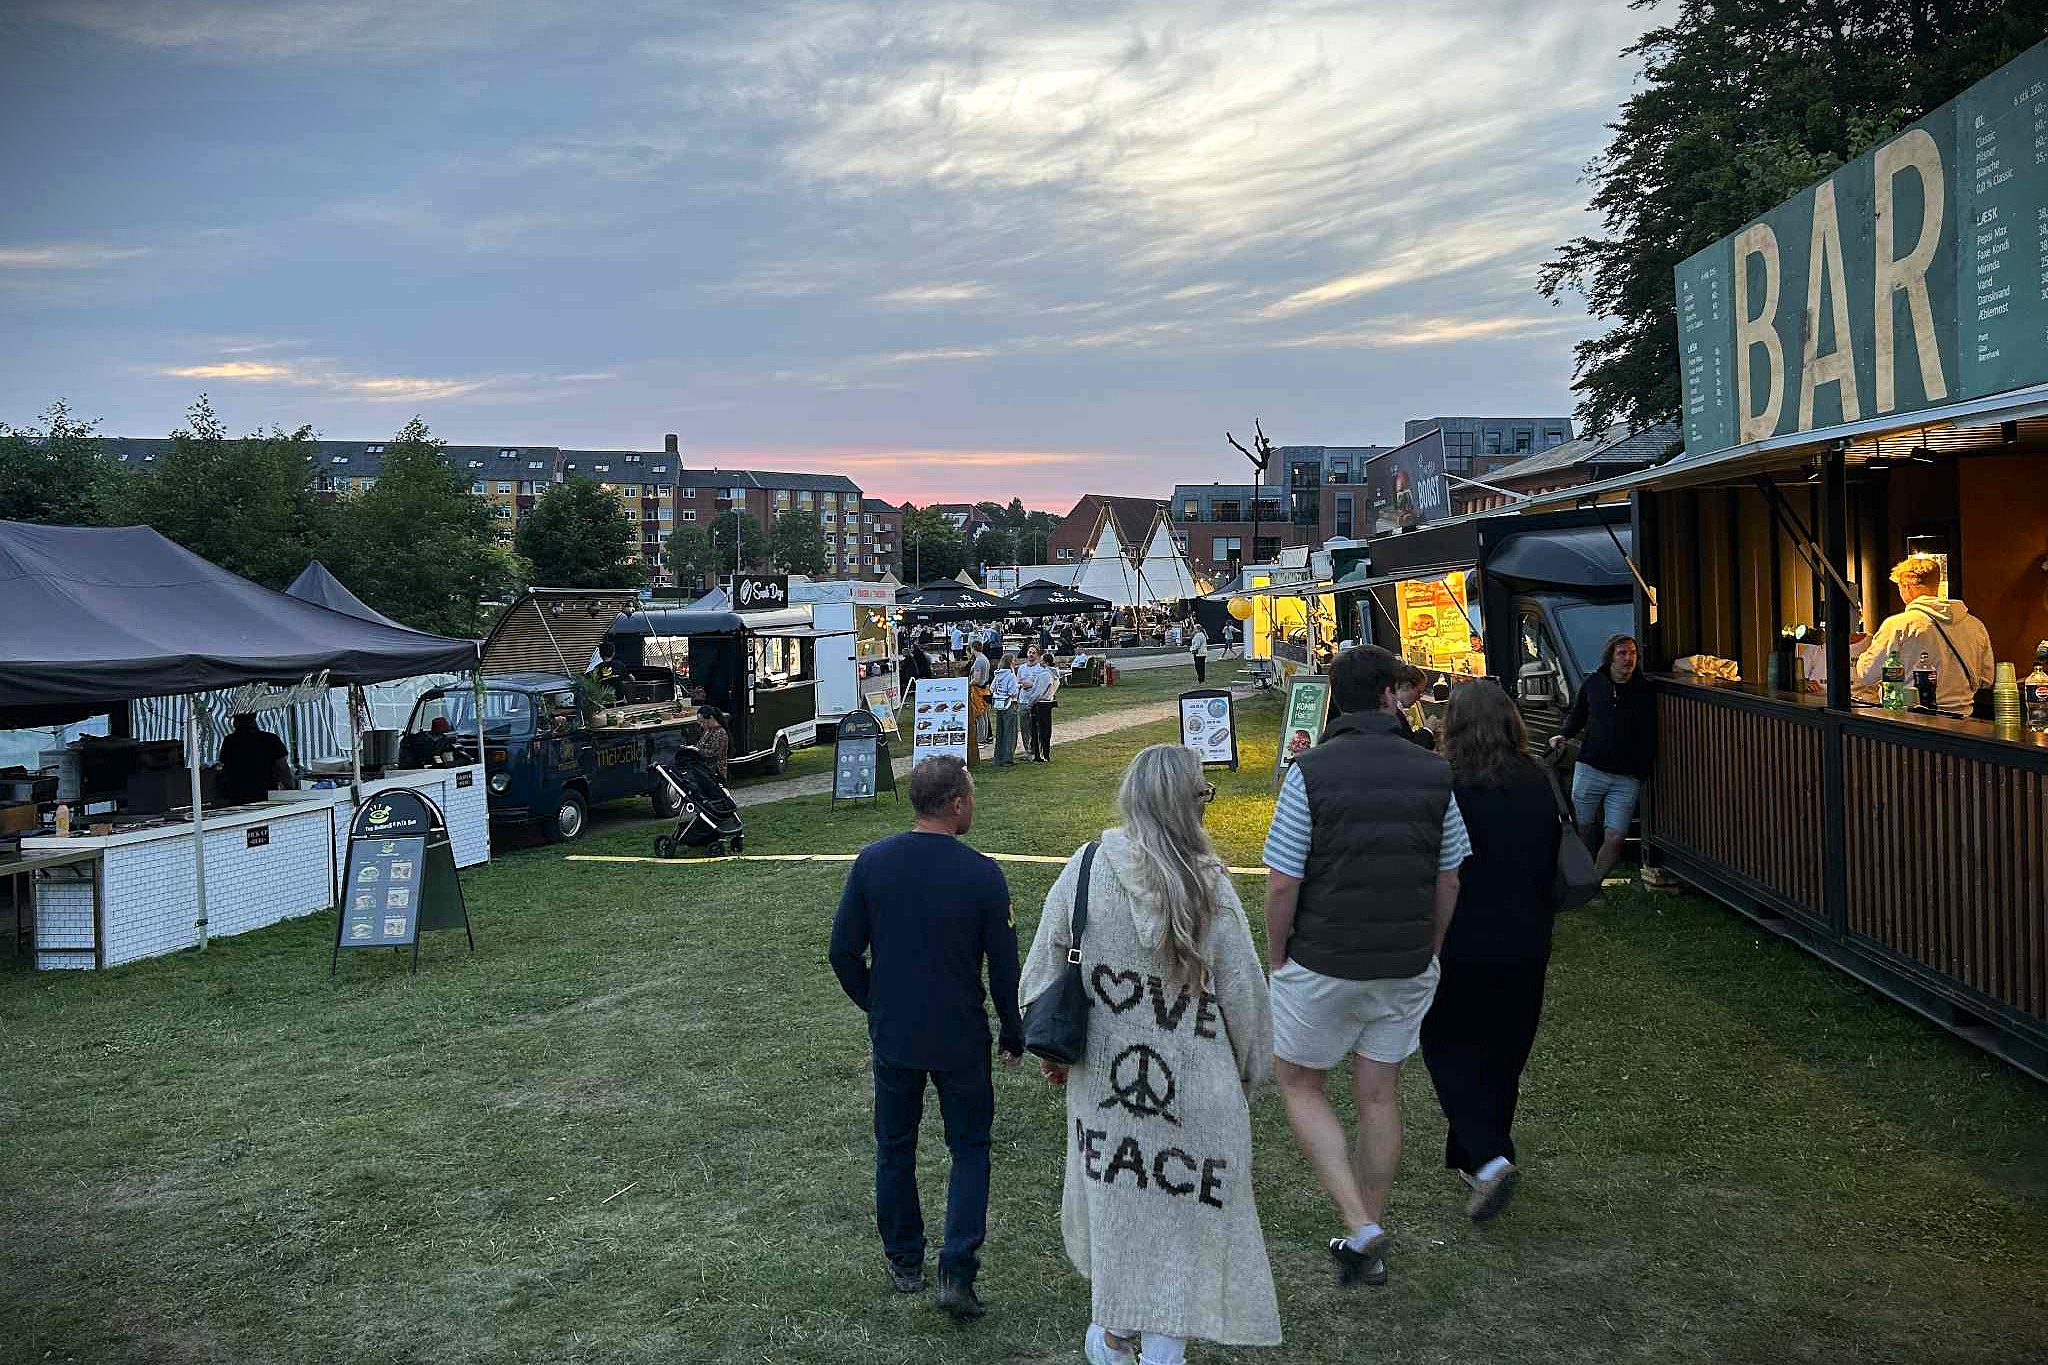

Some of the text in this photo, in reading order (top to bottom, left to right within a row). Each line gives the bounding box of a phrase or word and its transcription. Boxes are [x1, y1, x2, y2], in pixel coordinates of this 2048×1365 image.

[1977, 206, 1998, 227] LÆSK
[1734, 128, 1948, 446] BAR
[1417, 474, 1441, 510] BOOST
[956, 600, 997, 609] ROYAL
